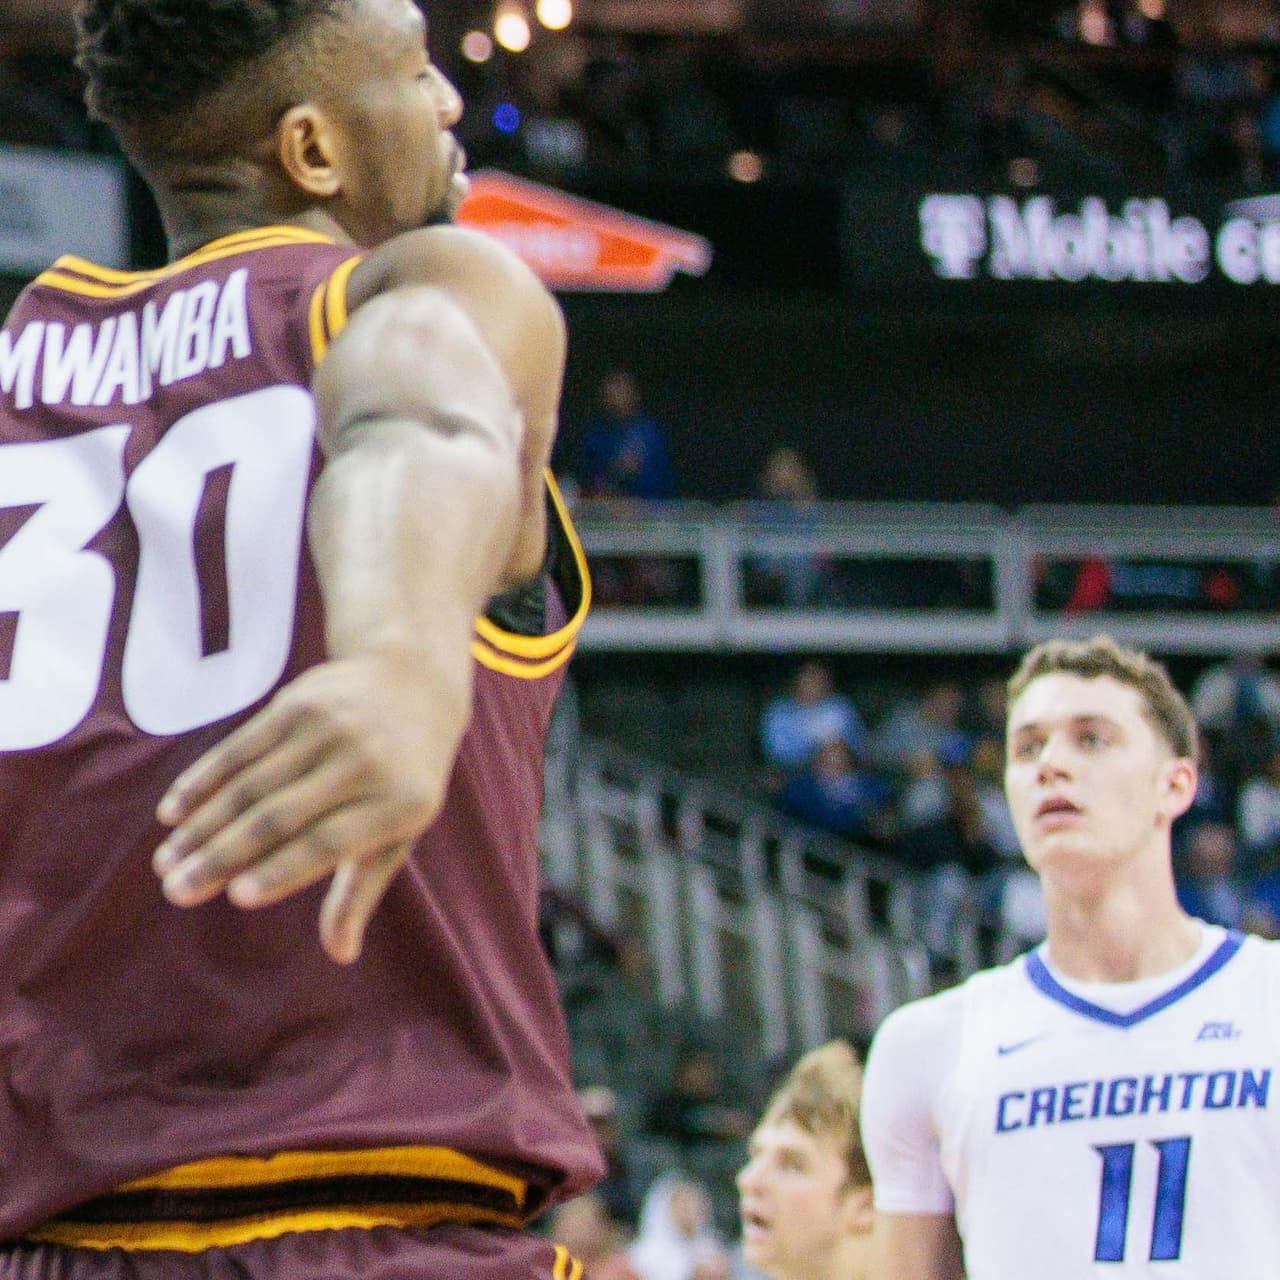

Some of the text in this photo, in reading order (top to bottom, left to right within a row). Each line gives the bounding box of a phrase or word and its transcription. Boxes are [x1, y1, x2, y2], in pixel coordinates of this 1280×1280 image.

[989, 195, 1209, 284] Mobile
[996, 1068, 1272, 1134] CREIGHTON
[1091, 1136, 1193, 1263] 11
